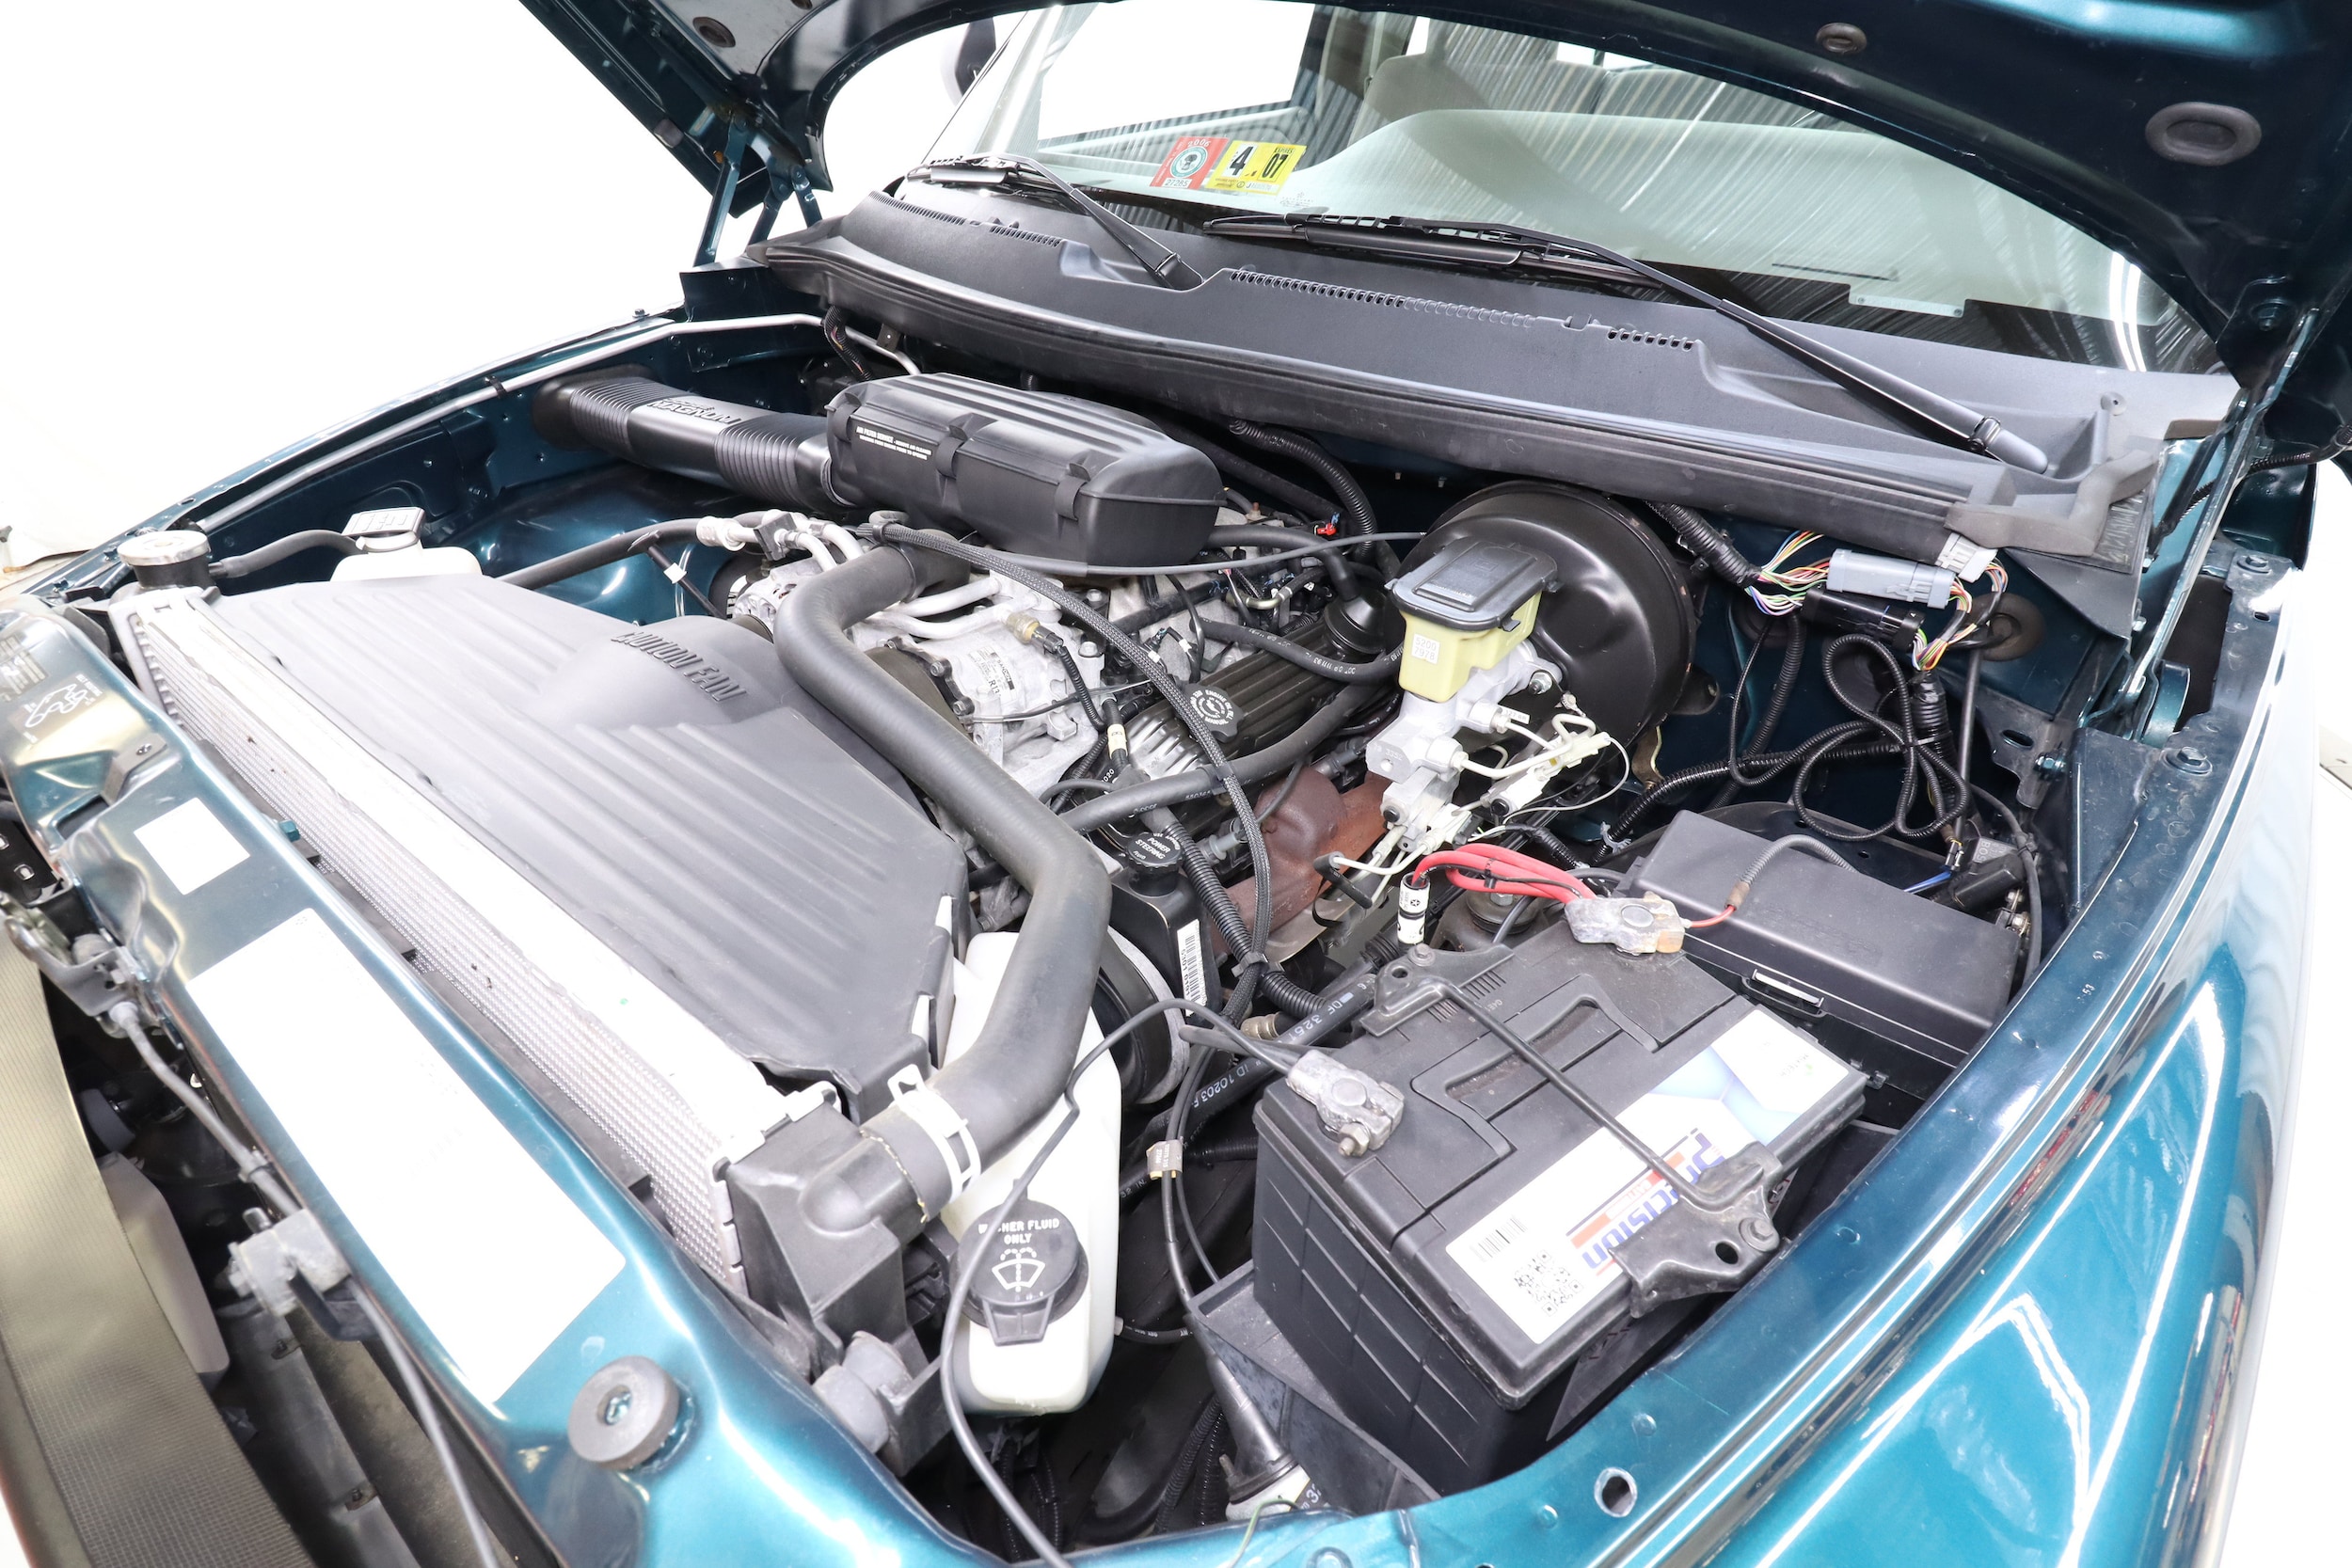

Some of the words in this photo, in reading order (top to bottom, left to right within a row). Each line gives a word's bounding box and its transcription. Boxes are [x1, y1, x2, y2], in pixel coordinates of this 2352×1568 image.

[1187, 138, 1211, 148] 2006
[1230, 146, 1254, 177] 4
[1262, 153, 1289, 179] 07
[1165, 179, 1189, 187] 27285
[647, 400, 741, 424] MAGNUM
[1415, 637, 1437, 651] 5200
[1415, 646, 1435, 660] 7978
[611, 631, 703, 669] CAUTION
[683, 664, 747, 702] FAN
[1205, 689, 1227, 702] ENGINE
[1136, 839, 1166, 859] STEERING
[1147, 837, 1171, 853] POWER
[1200, 1074, 1234, 1101] 10203
[977, 1221, 1025, 1234] WHER
[1027, 1218, 1059, 1230] FLUID
[1004, 1233, 1032, 1244] ONLY
